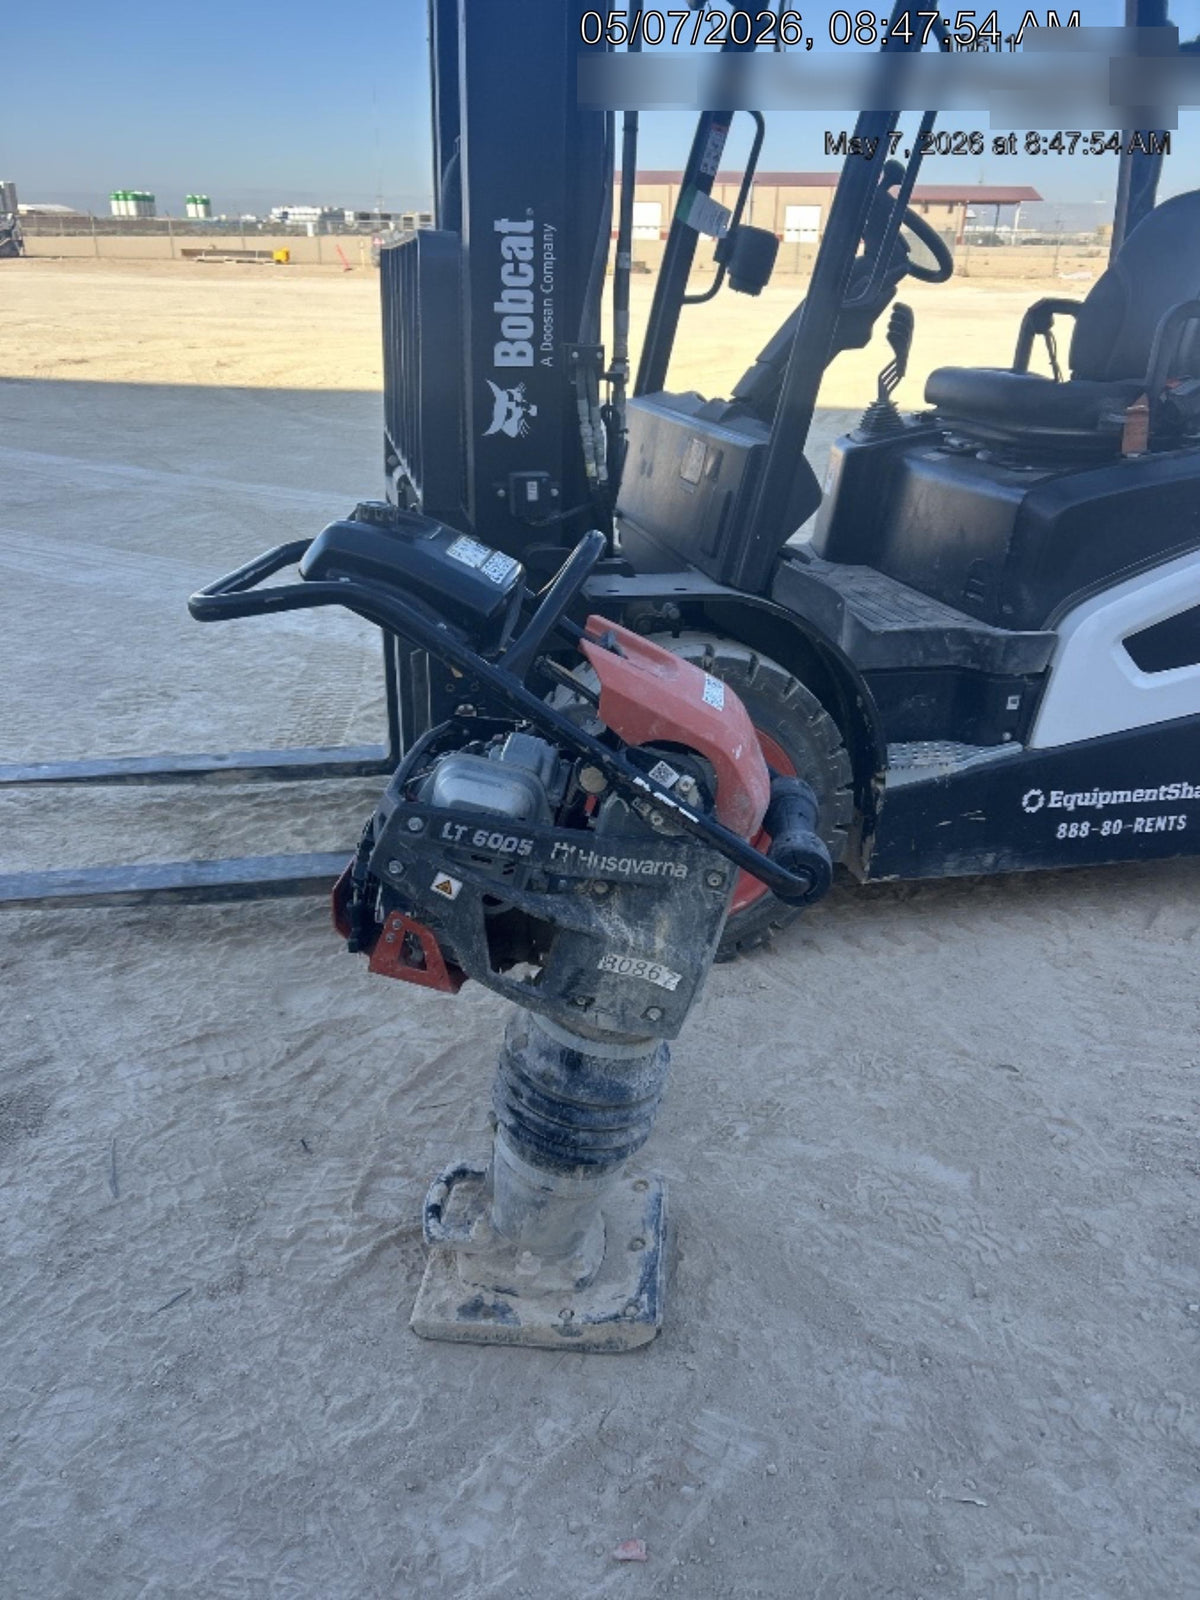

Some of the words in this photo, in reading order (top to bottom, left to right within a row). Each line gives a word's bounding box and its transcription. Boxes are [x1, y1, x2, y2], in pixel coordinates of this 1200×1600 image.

[540, 223, 557, 294] Company
[493, 218, 535, 368] Bobcat
[540, 300, 554, 350] Doosan
[540, 356, 554, 367] A
[440, 821, 468, 843] LT
[1056, 814, 1188, 840] 888-80-RENTS
